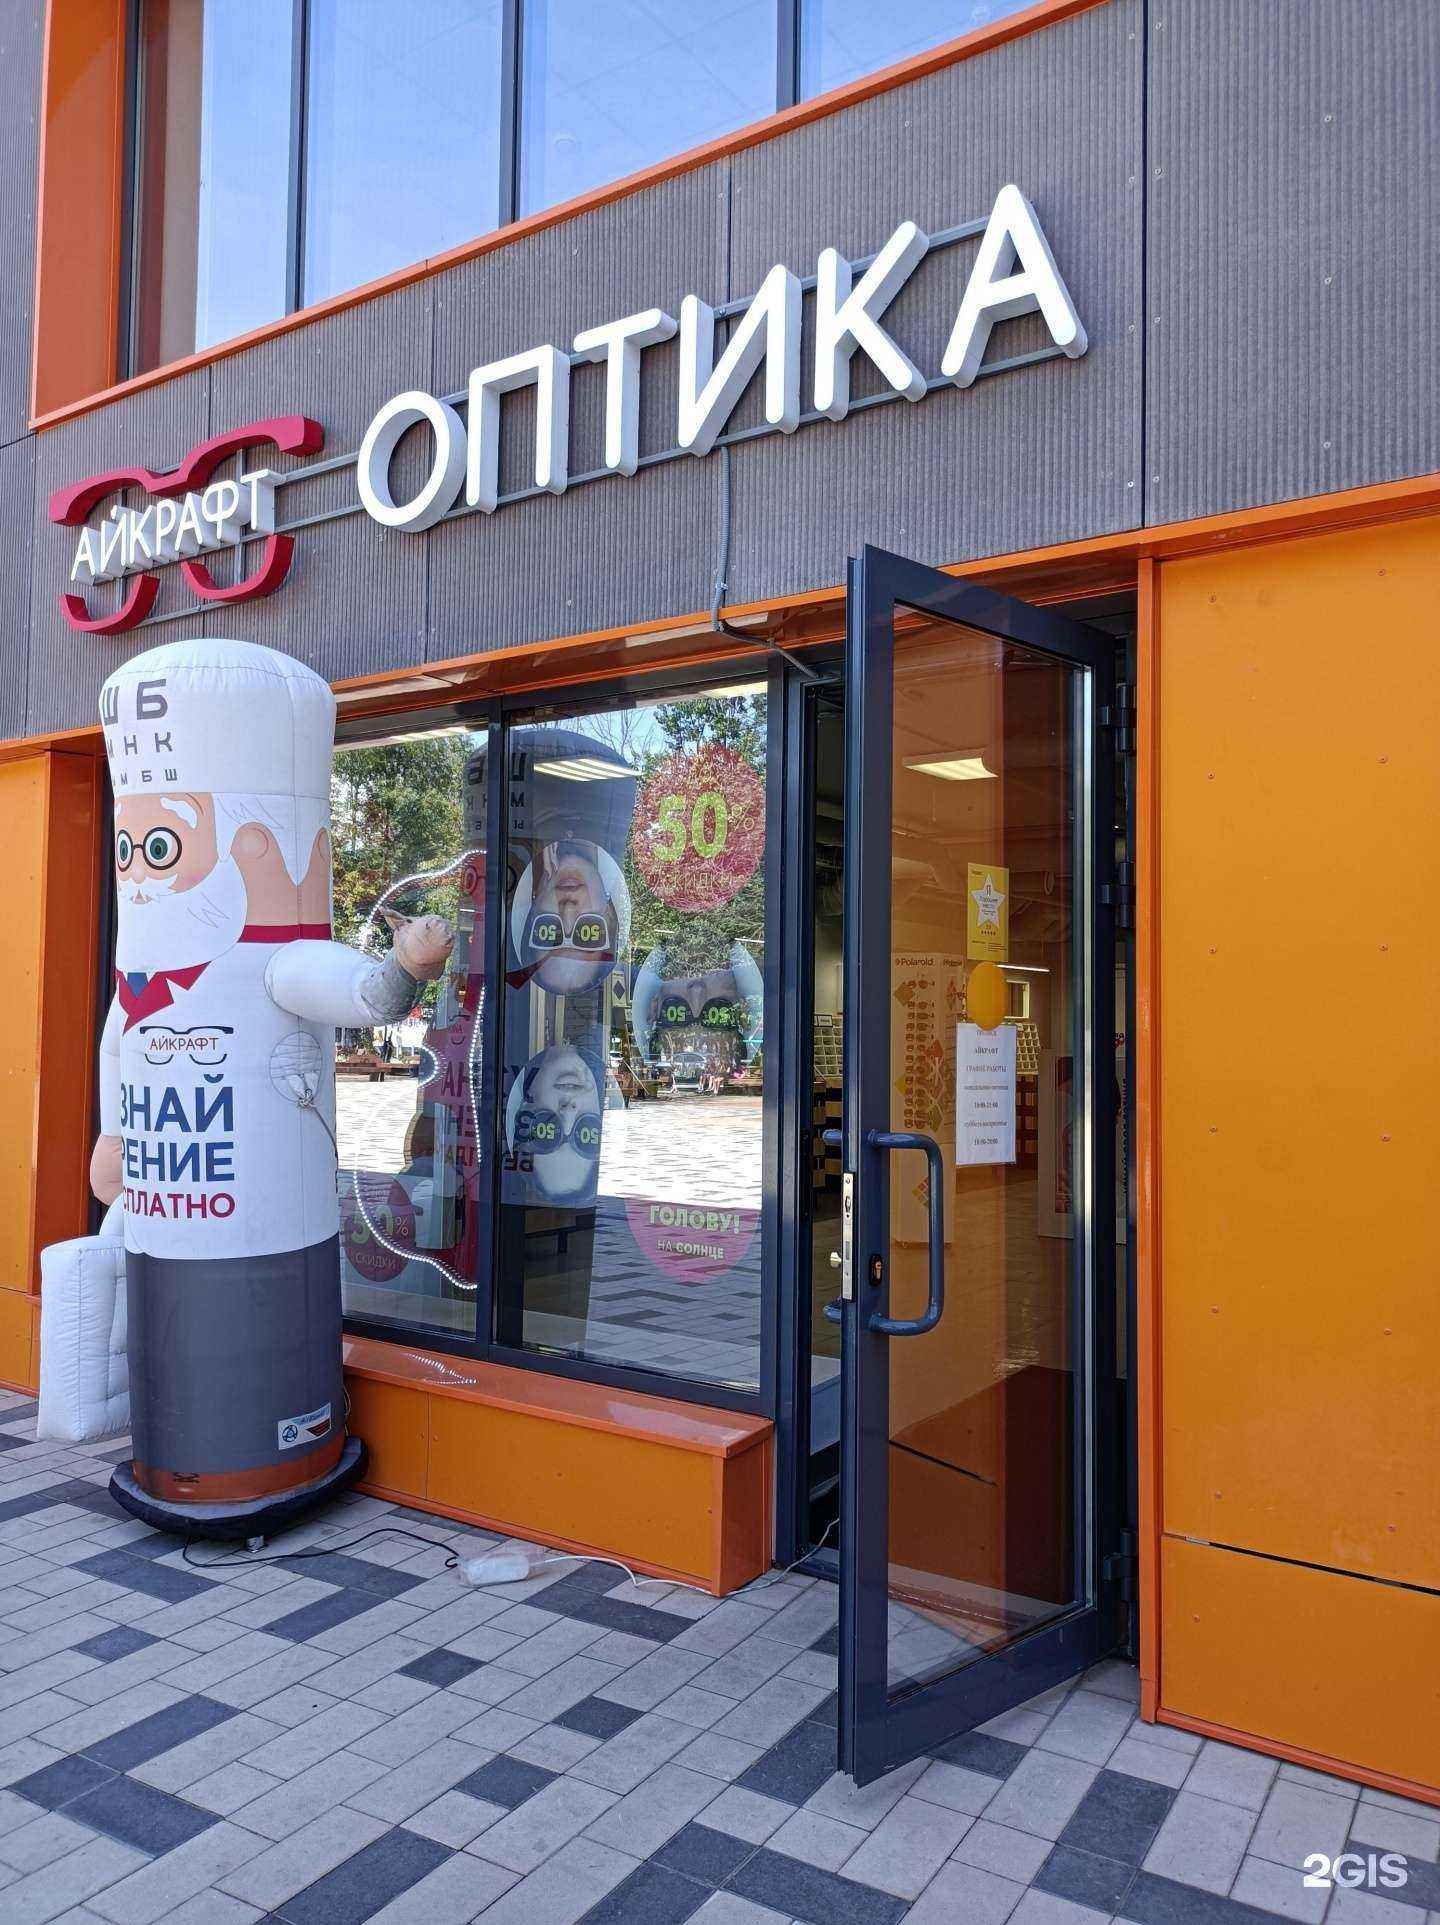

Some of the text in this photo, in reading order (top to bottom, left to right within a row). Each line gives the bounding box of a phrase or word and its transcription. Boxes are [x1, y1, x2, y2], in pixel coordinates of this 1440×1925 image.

[356, 184, 1087, 532] ОПТИКА
[70, 468, 274, 584] АЙКРАФТ
[136, 679, 168, 720] Б
[124, 735, 138, 756] Н
[155, 732, 173, 753] К
[141, 770, 152, 782] Б
[164, 769, 178, 781] Ш
[900, 957, 934, 966] Polaroid
[149, 1035, 219, 1051] АЙКРАФТ
[649, 1204, 741, 1235] ГОЛОВУ!
[355, 1252, 397, 1269] СКИДКИ
[675, 1241, 725, 1260] СОЛНЦЕ
